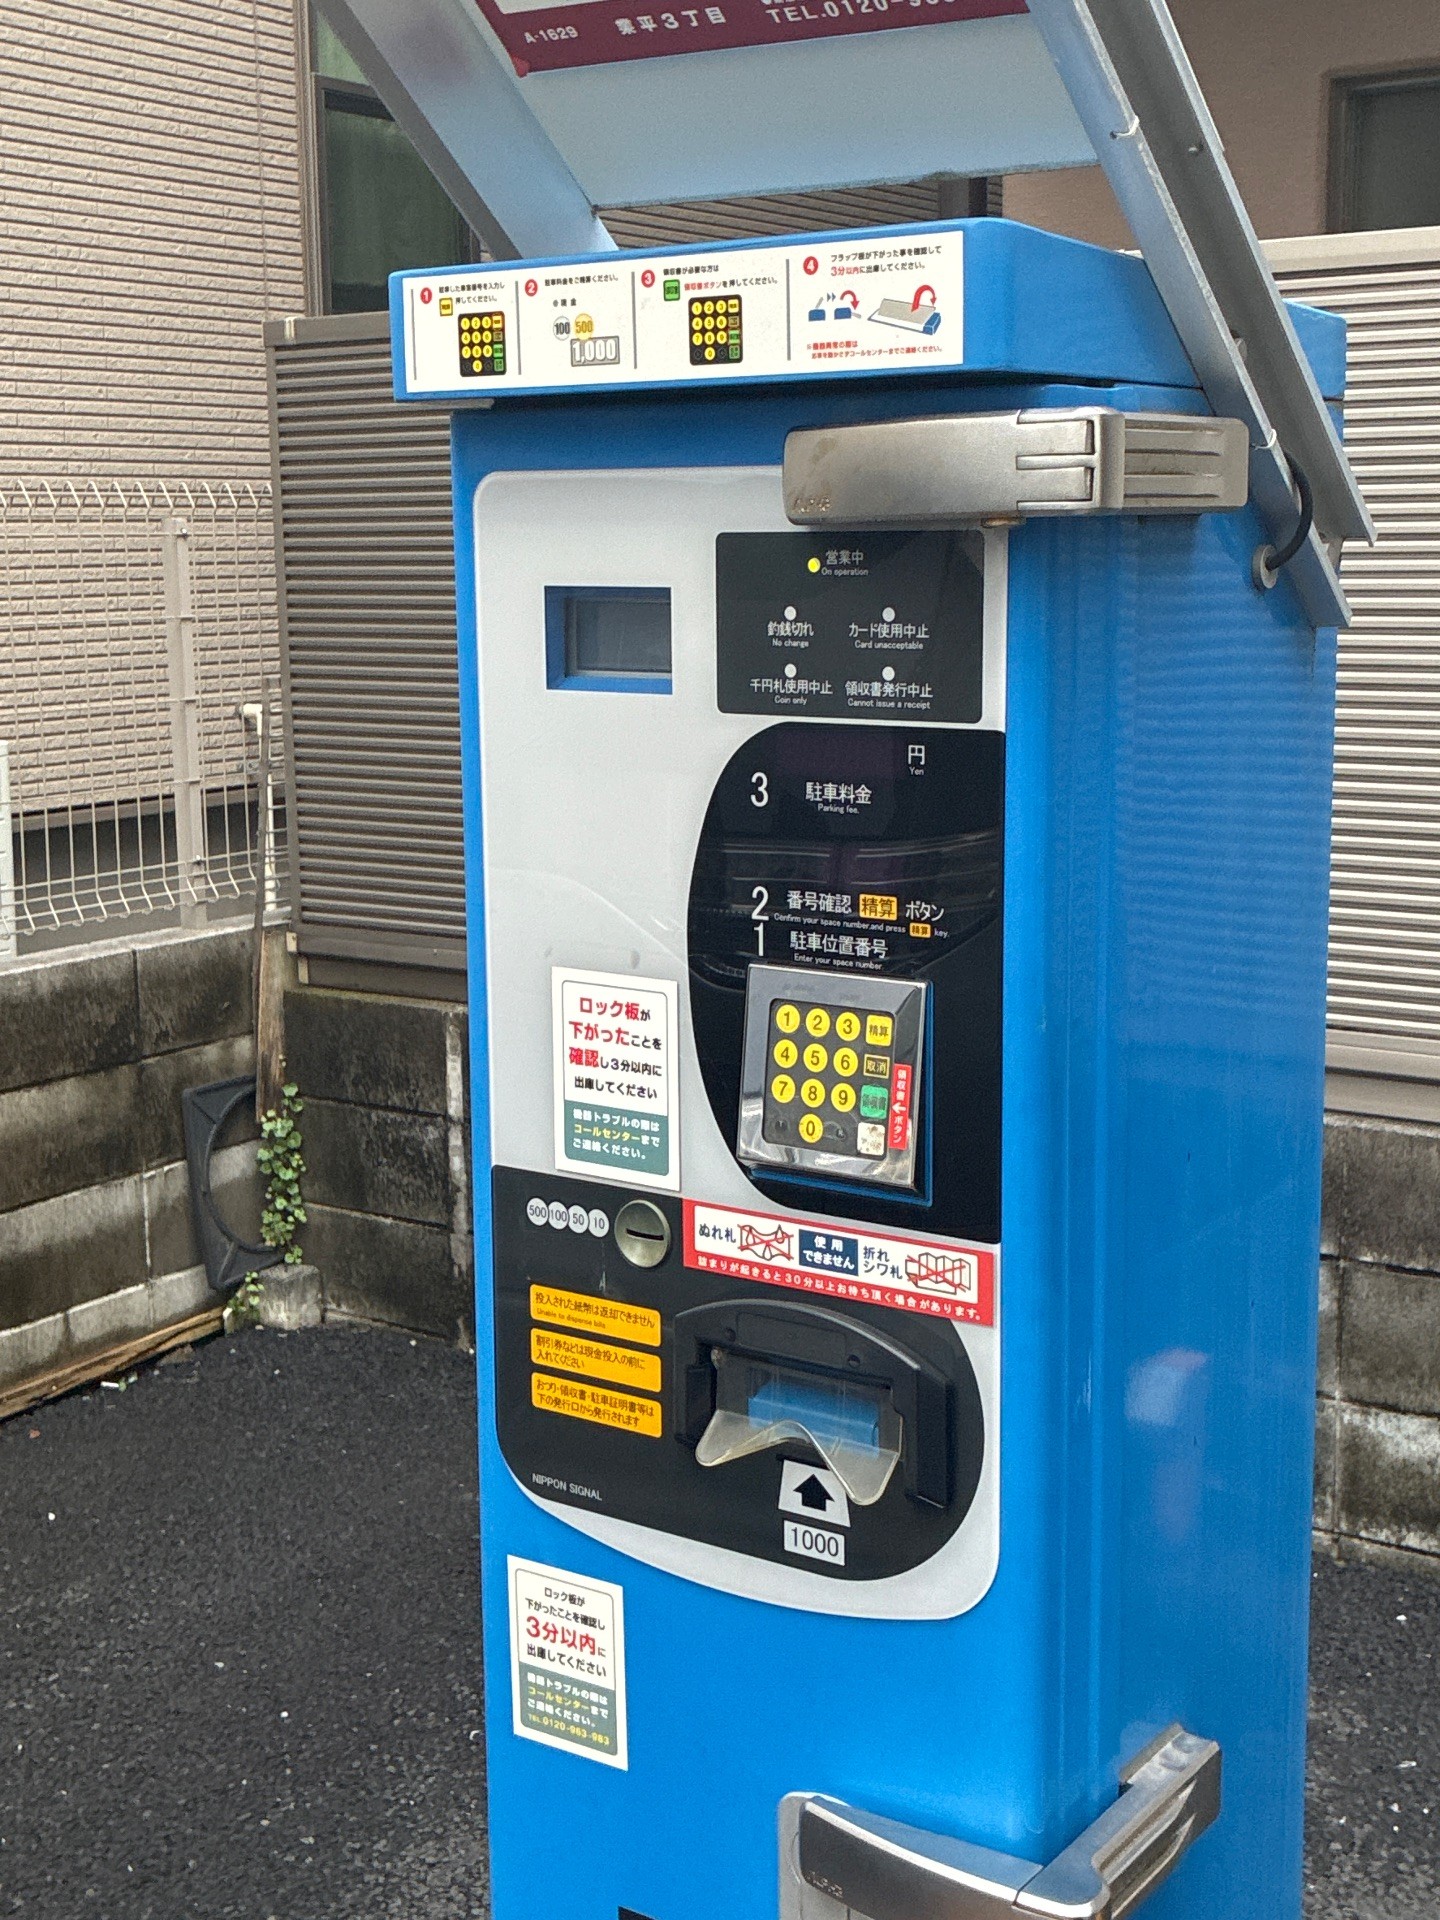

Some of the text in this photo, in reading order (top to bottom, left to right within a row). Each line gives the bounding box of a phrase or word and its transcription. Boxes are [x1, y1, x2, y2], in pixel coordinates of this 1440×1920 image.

[524, 25, 578, 44] A-1629
[806, 259, 815, 272] 4
[527, 282, 536, 294] 2
[644, 273, 652, 285] 3
[554, 320, 594, 335] 100 500
[572, 339, 618, 364] 1,000
[825, 549, 864, 566] 営業中
[821, 567, 869, 577] On operation
[767, 620, 815, 637] 釣銭切れ
[848, 622, 930, 640] カード使用中止
[772, 639, 809, 649] No change
[854, 640, 924, 650] Card unacceptable
[749, 678, 833, 695] 千円札使用中止
[844, 681, 933, 698] 領収書発行中止
[774, 695, 808, 706] Coin only
[847, 698, 874, 708] Cannot
[875, 699, 895, 708] issue
[903, 700, 931, 710] receipt
[907, 744, 926, 765] 円
[909, 767, 925, 776] Yen
[750, 772, 872, 807] 3 駐車料金
[817, 803, 860, 814] Parking fee.
[751, 886, 945, 922] 2 番号確認 精算 ボタン
[773, 912, 801, 923] Confirm
[802, 916, 819, 926] your
[820, 918, 841, 928] space
[885, 925, 907, 934] press
[911, 924, 930, 936] 精算
[934, 927, 950, 939] key.
[753, 922, 889, 959] 1 駐車位置番号
[794, 952, 813, 963] Enter
[815, 955, 831, 966] your
[832, 957, 854, 968] space
[580, 997, 652, 1021] ロック板が
[568, 1020, 662, 1050] 下がったことを
[784, 1012, 890, 1038] 1 2 3 精算
[568, 1046, 663, 1077] 確認し3分以内に
[781, 1046, 887, 1074] 4 5 6 取消
[574, 1076, 658, 1100] 出庫してください
[778, 1081, 788, 1096] 7
[808, 1085, 818, 1101] 8
[838, 1089, 848, 1105] 9
[574, 1124, 660, 1148] コールセンターまで
[806, 1121, 815, 1136] 0
[893, 1115, 904, 1144] ボタン
[573, 1137, 646, 1160] ご連絡ください。
[528, 1206, 605, 1230] 500 100 50 10
[699, 1223, 737, 1244] ぬれ札
[814, 1235, 844, 1252] 使用
[803, 1249, 855, 1270] できません
[863, 1245, 890, 1263] 折れ
[863, 1260, 903, 1280] シワ札
[697, 1255, 980, 1321] 詰まりが起きると30分以上お待ち頂く場合があります。
[535, 1291, 655, 1329] 投入された紙幣は返却できません
[536, 1307, 557, 1318] Unable
[535, 1334, 646, 1370] 割引券などは現金投入の前に
[536, 1348, 585, 1369] 入れてください
[537, 1392, 640, 1427] 下の発行口から発行されます
[532, 1473, 603, 1501] NIPPON SIGNAL
[791, 1526, 840, 1557] 1000
[544, 1586, 586, 1607] ロック板が
[525, 1597, 606, 1631] 下がったことを確認し
[526, 1615, 607, 1658] 3分以内に
[527, 1643, 607, 1677] 出庫してください
[527, 1686, 609, 1719] コールセンターまで
